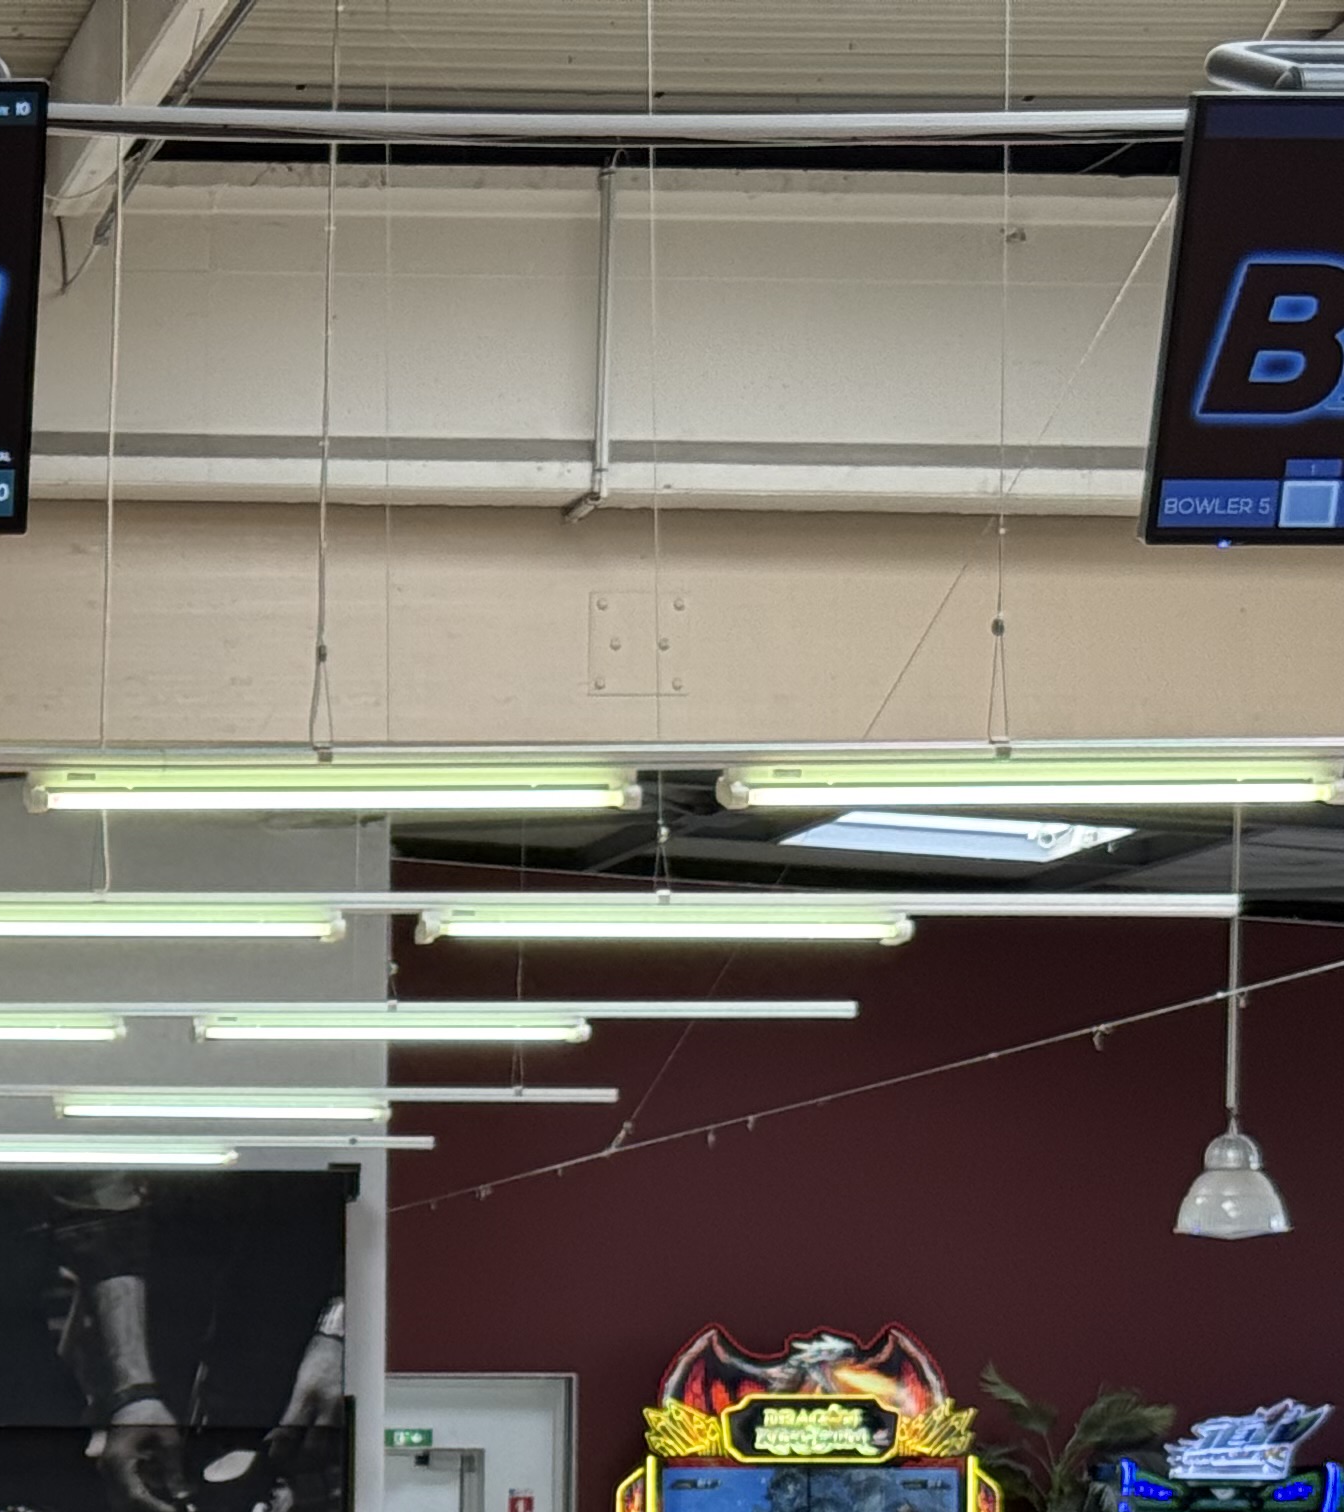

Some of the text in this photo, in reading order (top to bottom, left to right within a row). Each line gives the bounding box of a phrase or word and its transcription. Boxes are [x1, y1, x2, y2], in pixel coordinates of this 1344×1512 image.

[16, 101, 31, 116] 10
[1164, 498, 1271, 516] BOWLER 5
